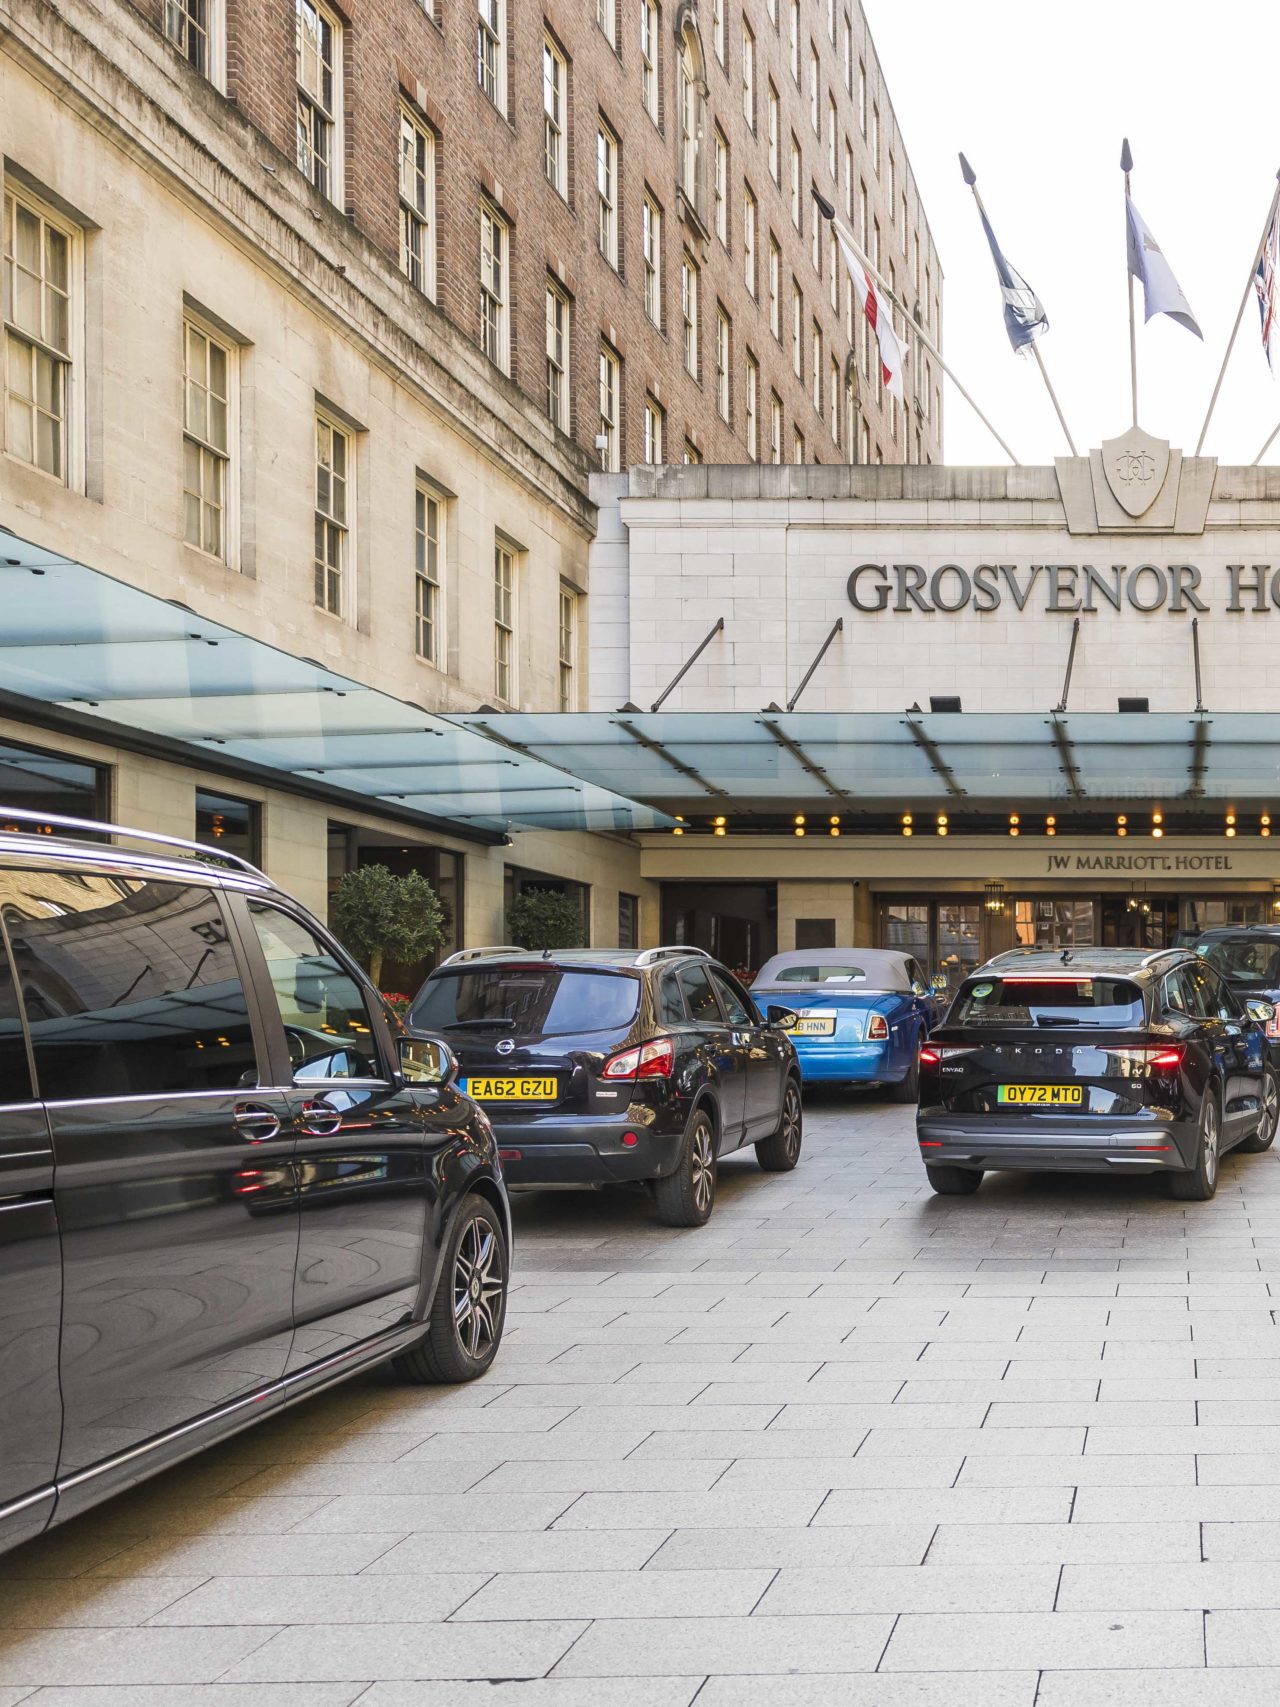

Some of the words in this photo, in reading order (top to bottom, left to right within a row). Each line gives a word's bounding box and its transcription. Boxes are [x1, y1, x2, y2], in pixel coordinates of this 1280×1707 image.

[846, 563, 1210, 612] GROSVENOR
[1047, 855, 1071, 872] JW
[1175, 856, 1233, 870] HOTEL
[471, 1080, 516, 1096] EA62
[520, 1080, 554, 1096] GZU
[1007, 1087, 1047, 1101] OY72
[1051, 1087, 1081, 1102] MTO
